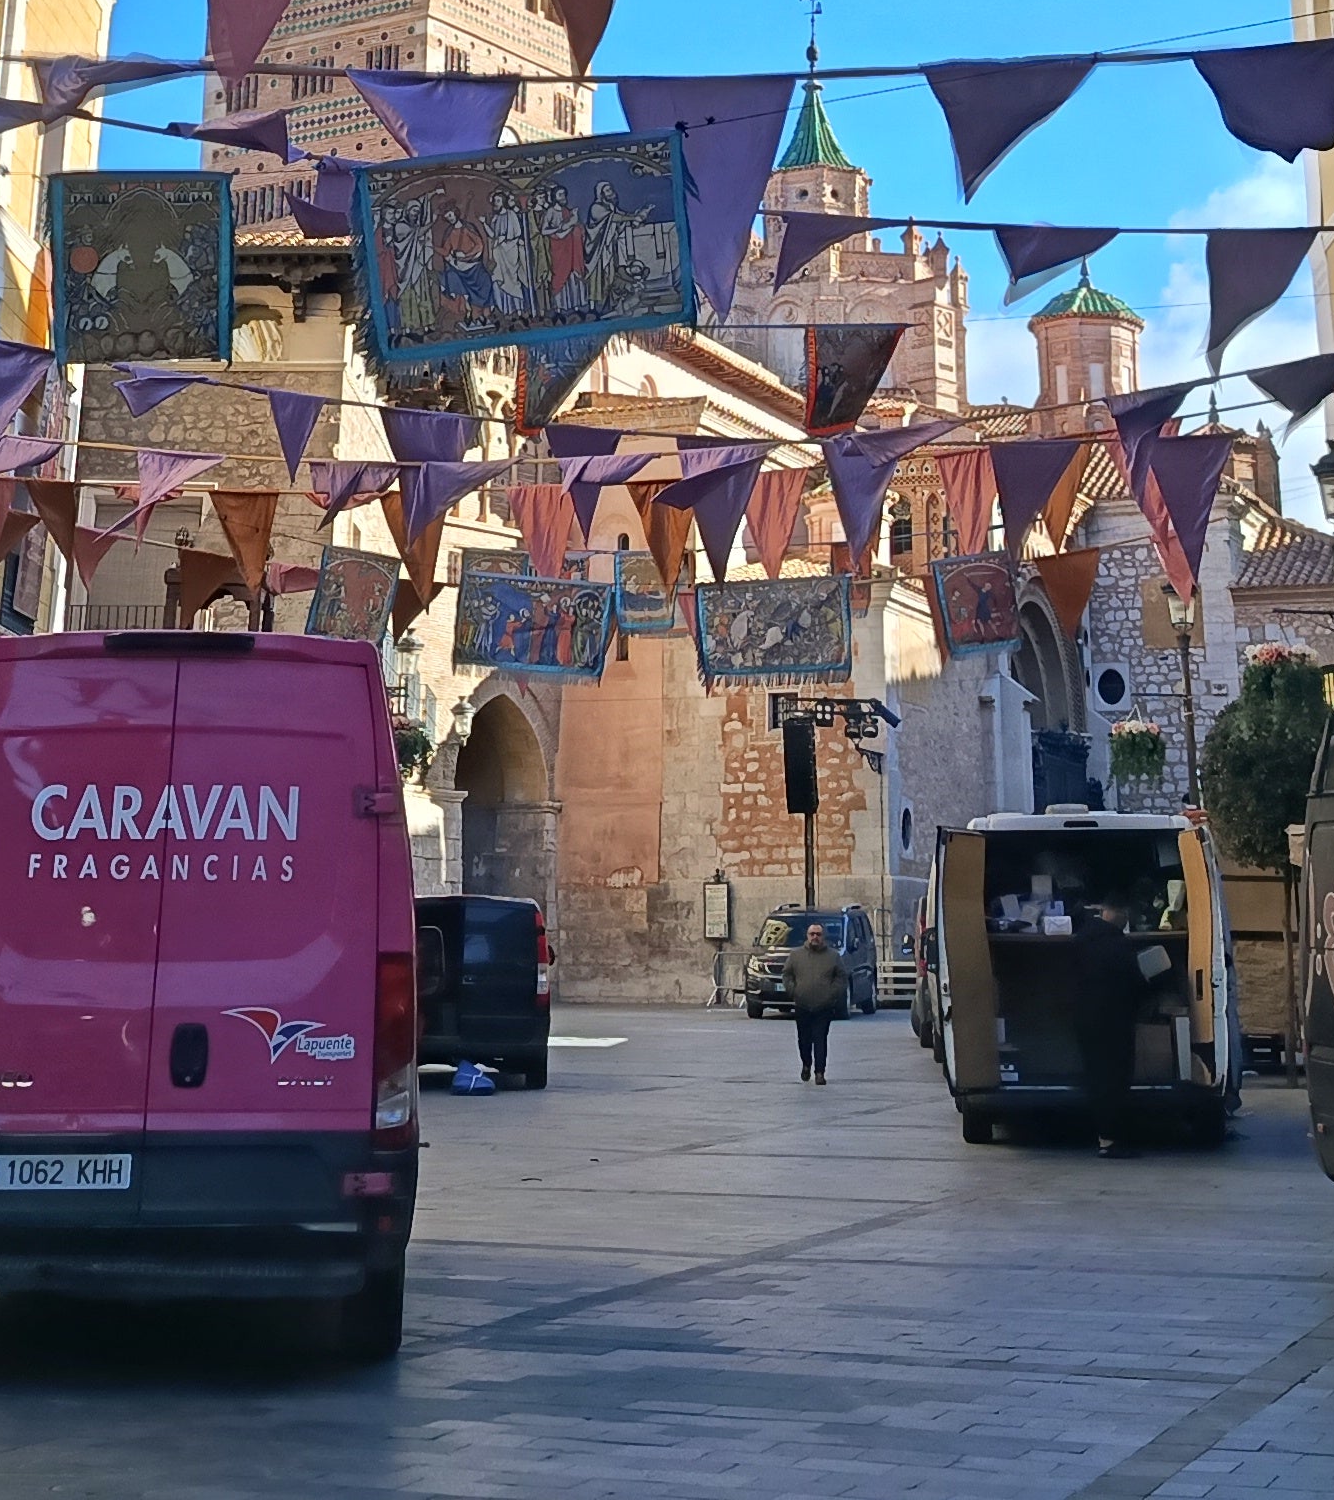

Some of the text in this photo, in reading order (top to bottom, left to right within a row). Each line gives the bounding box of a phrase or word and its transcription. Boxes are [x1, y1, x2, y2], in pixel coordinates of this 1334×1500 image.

[31, 783, 300, 841] CARAVAN
[27, 853, 294, 882] FRAGANCIAS
[297, 1037, 352, 1053] Lapuente
[7, 1158, 123, 1185] 1062 KHH
